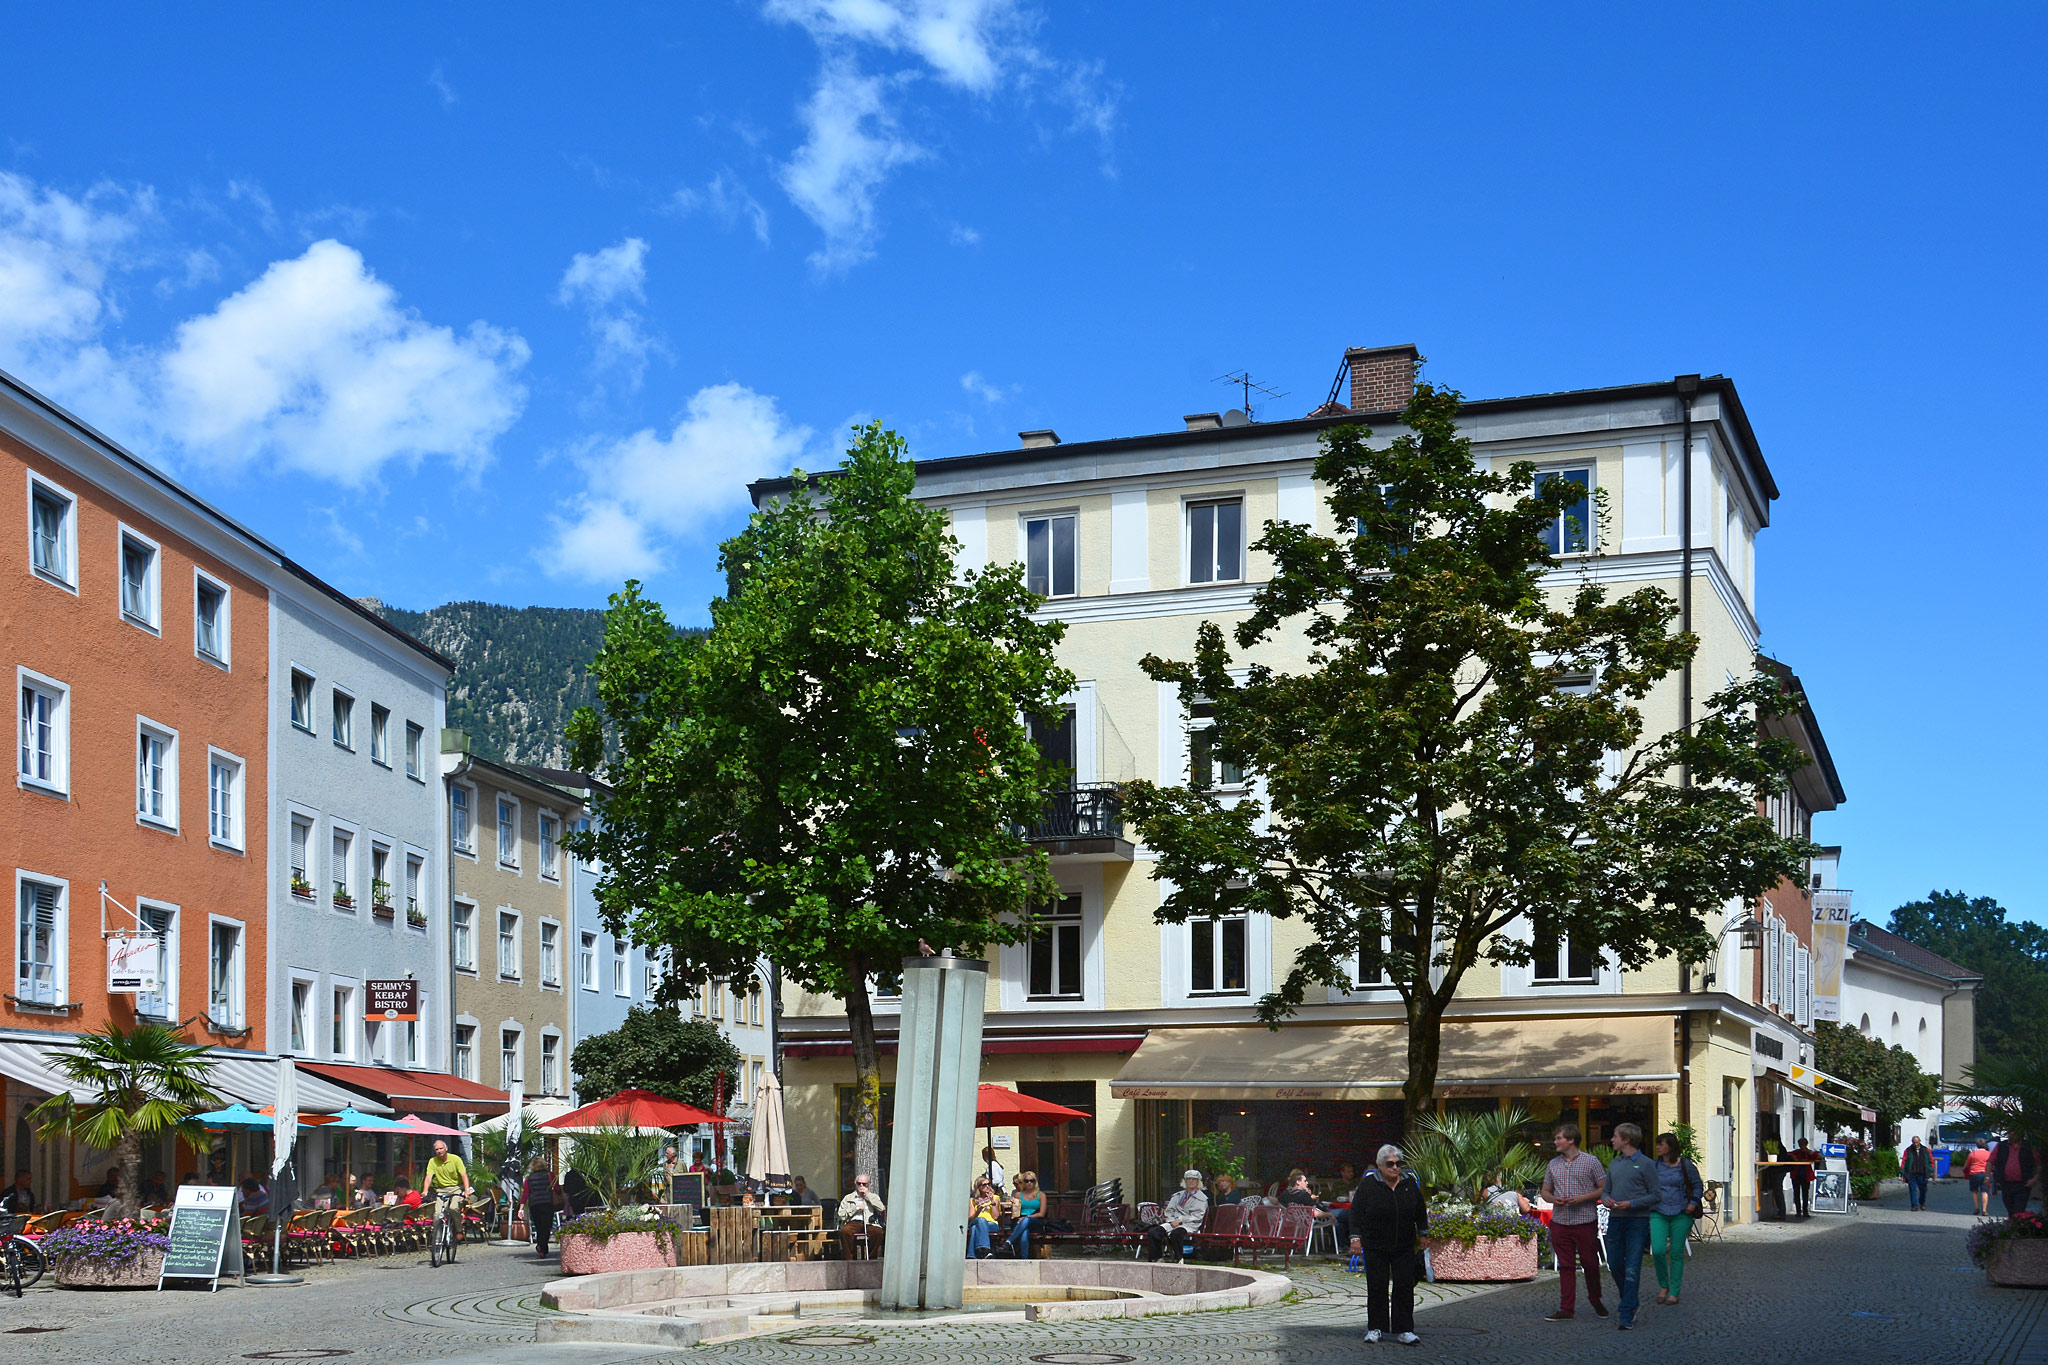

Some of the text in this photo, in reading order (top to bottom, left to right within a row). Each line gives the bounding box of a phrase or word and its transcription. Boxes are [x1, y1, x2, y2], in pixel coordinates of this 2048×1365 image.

[375, 991, 408, 1000] KEBAP
[374, 1000, 408, 1009] BISTRO
[1122, 1087, 1168, 1098] Café Lounge
[1275, 1087, 1323, 1098] Café Lounge
[1608, 1082, 1661, 1093] Café Lounge
